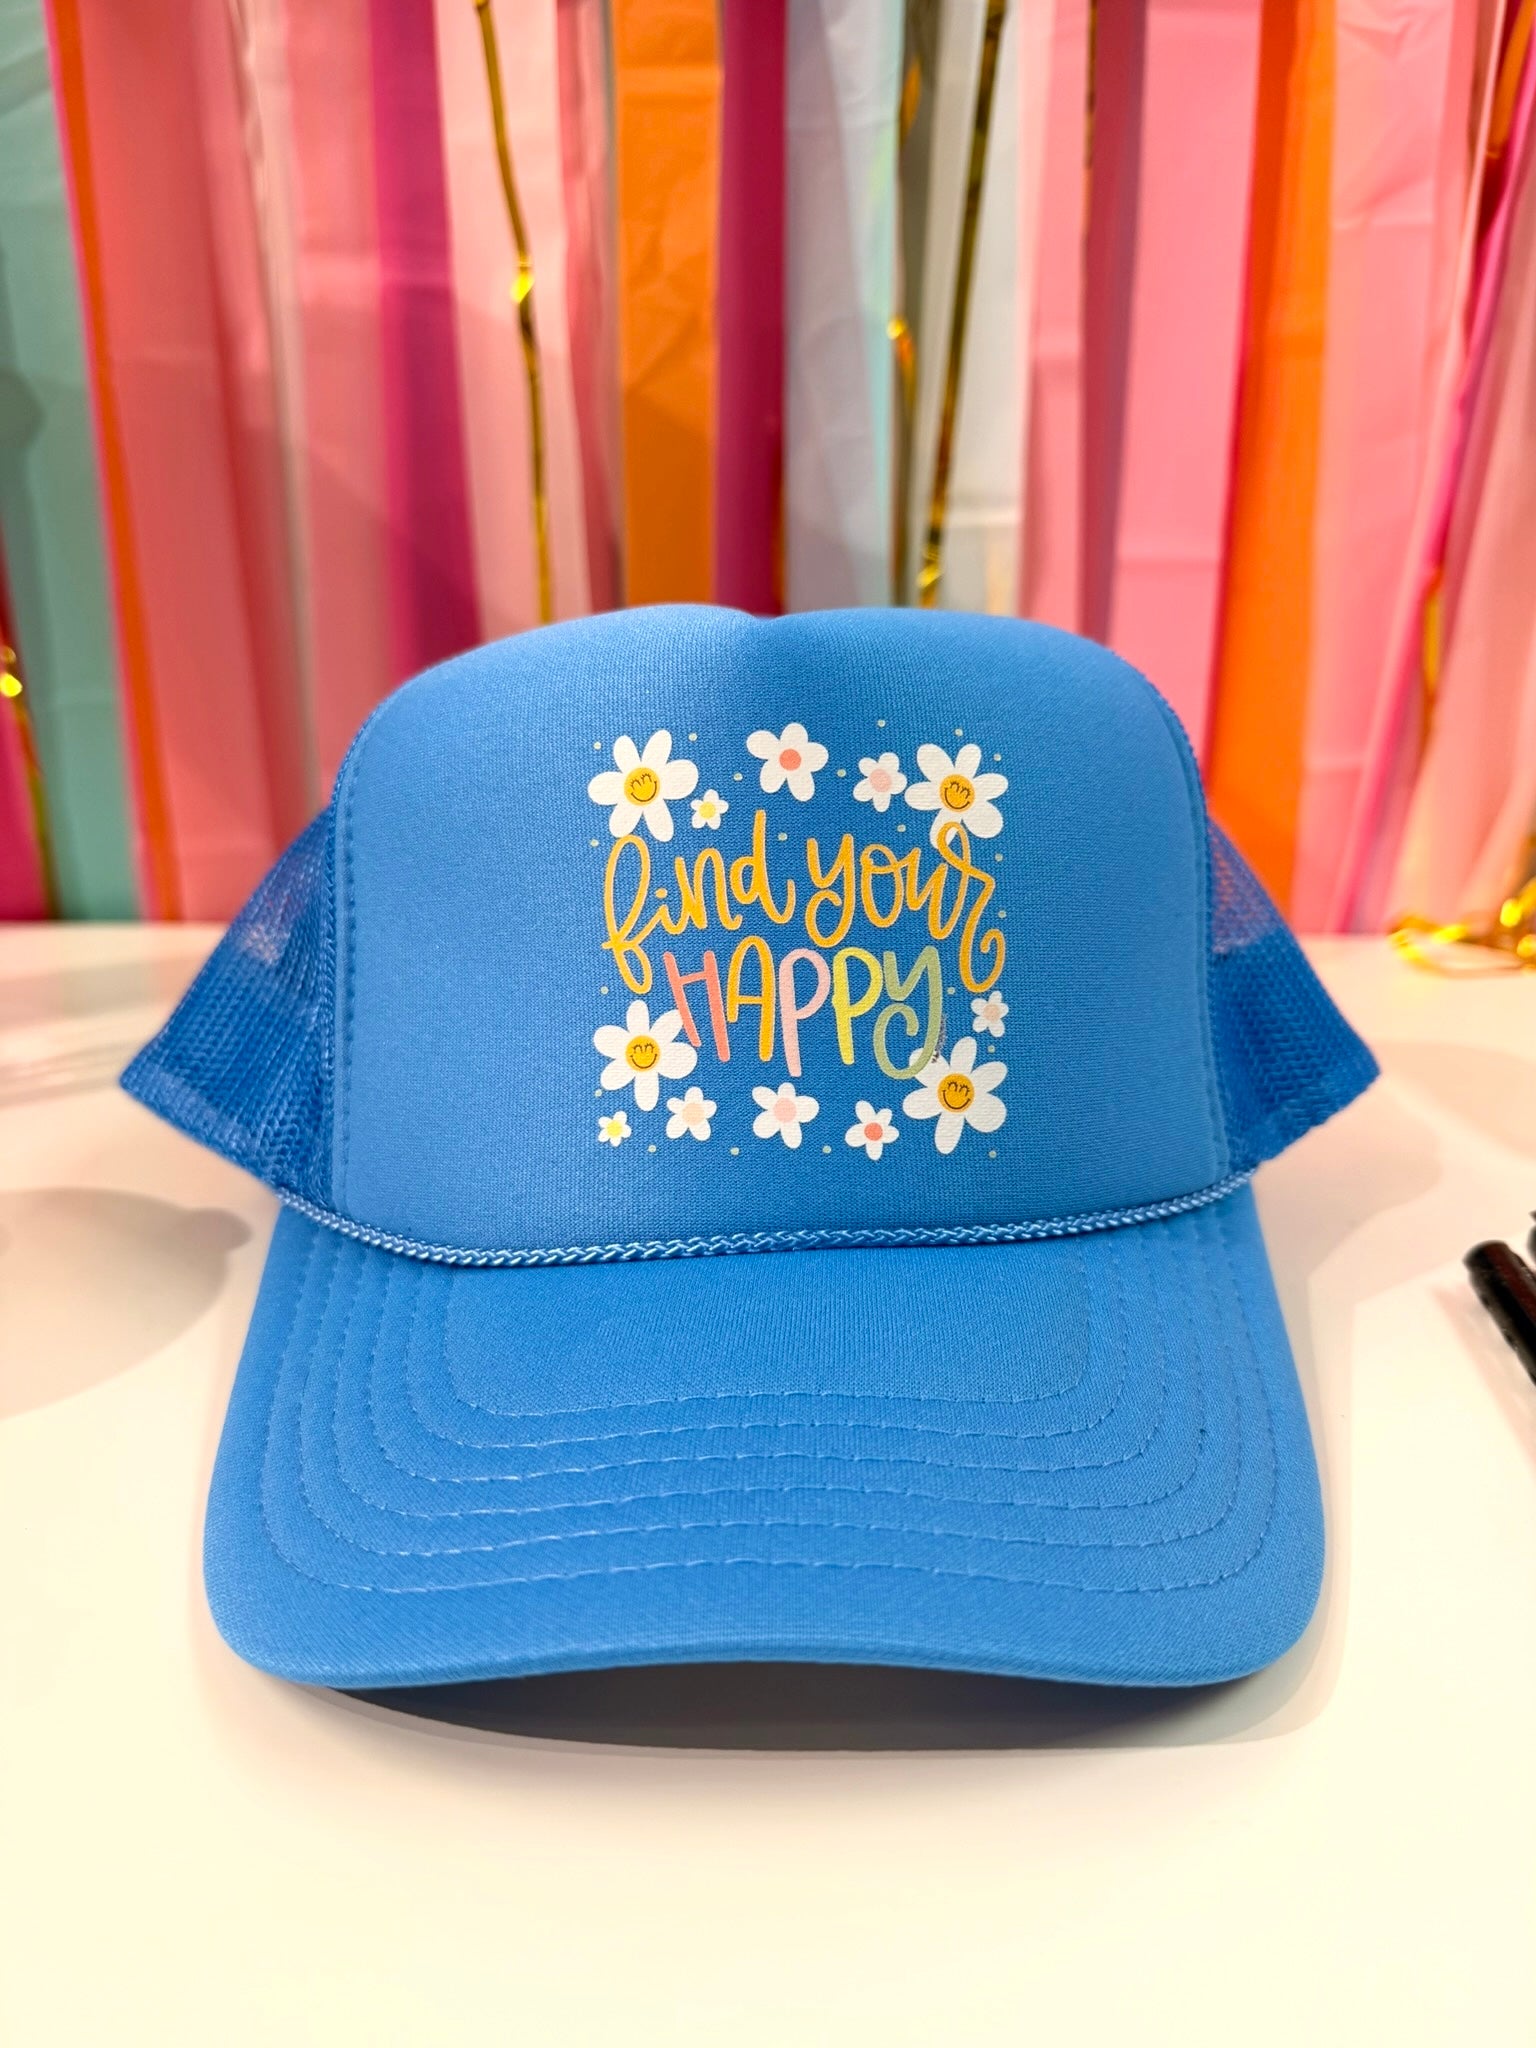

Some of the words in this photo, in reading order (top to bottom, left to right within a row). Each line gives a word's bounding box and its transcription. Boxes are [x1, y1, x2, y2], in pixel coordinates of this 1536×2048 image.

[602, 810, 796, 994] find
[804, 821, 1006, 993] your
[663, 935, 943, 1080] HAPPY
